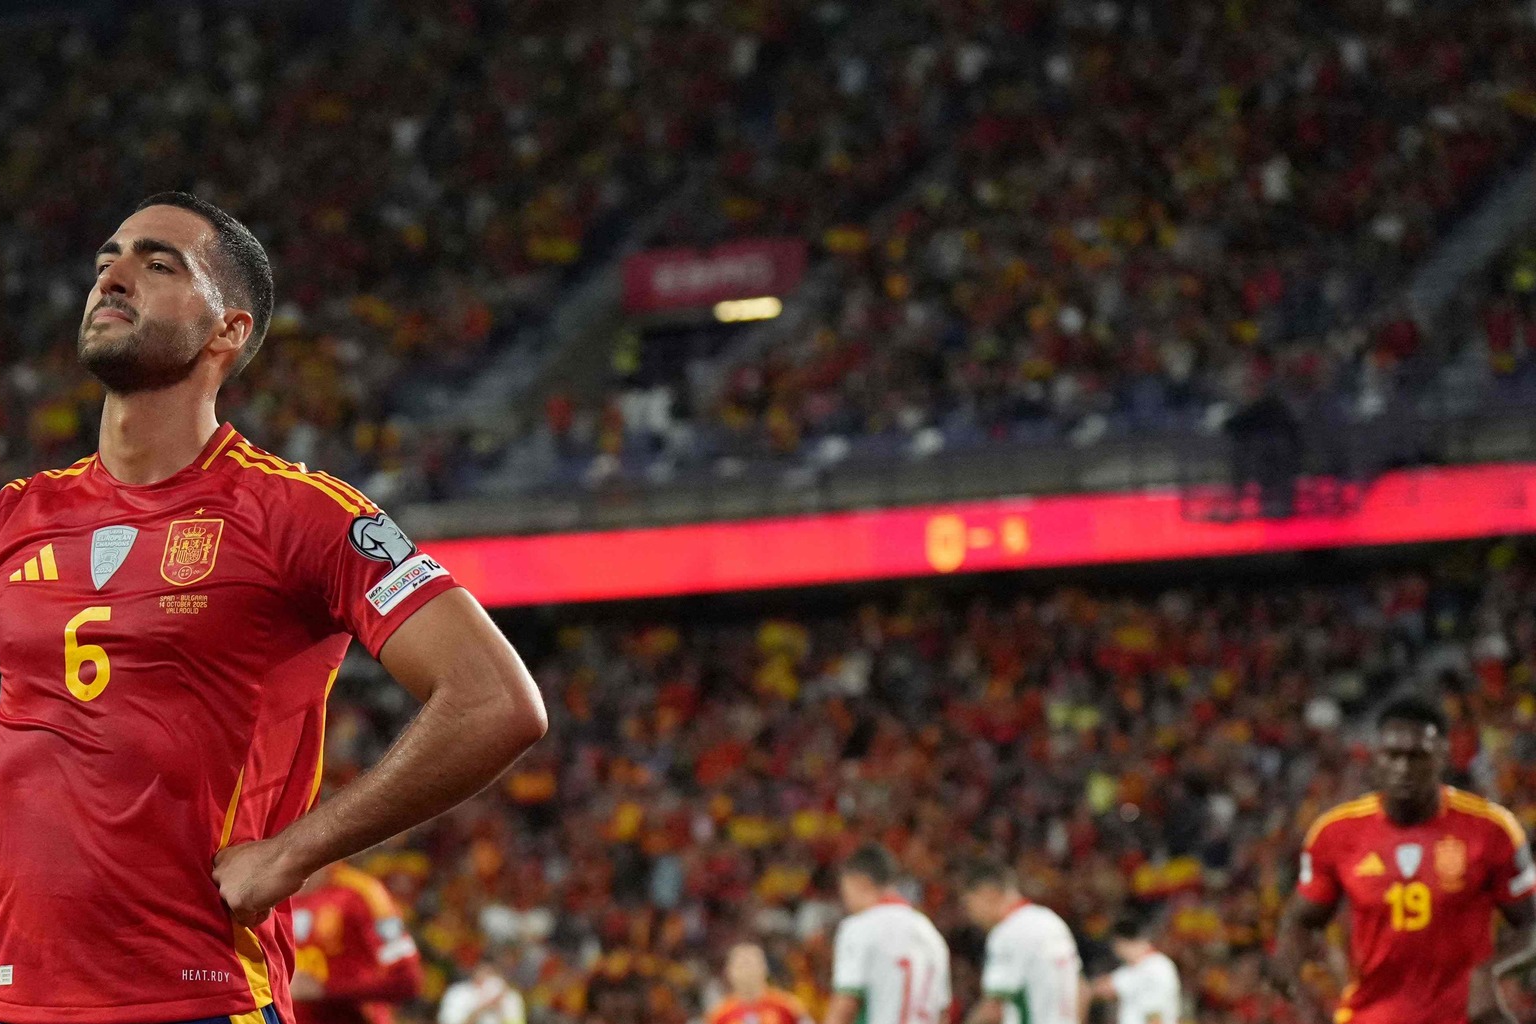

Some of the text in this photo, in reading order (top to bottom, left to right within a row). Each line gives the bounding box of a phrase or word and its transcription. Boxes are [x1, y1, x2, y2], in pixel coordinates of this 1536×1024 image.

[96, 534, 132, 542] EUROPEAN
[368, 586, 383, 599] UEFA
[374, 565, 426, 607] FOUNDATION
[180, 594, 208, 602] BULGARIA
[64, 606, 112, 702] 6
[1384, 881, 1432, 932] 19
[181, 969, 230, 983] HEAT.RDY
